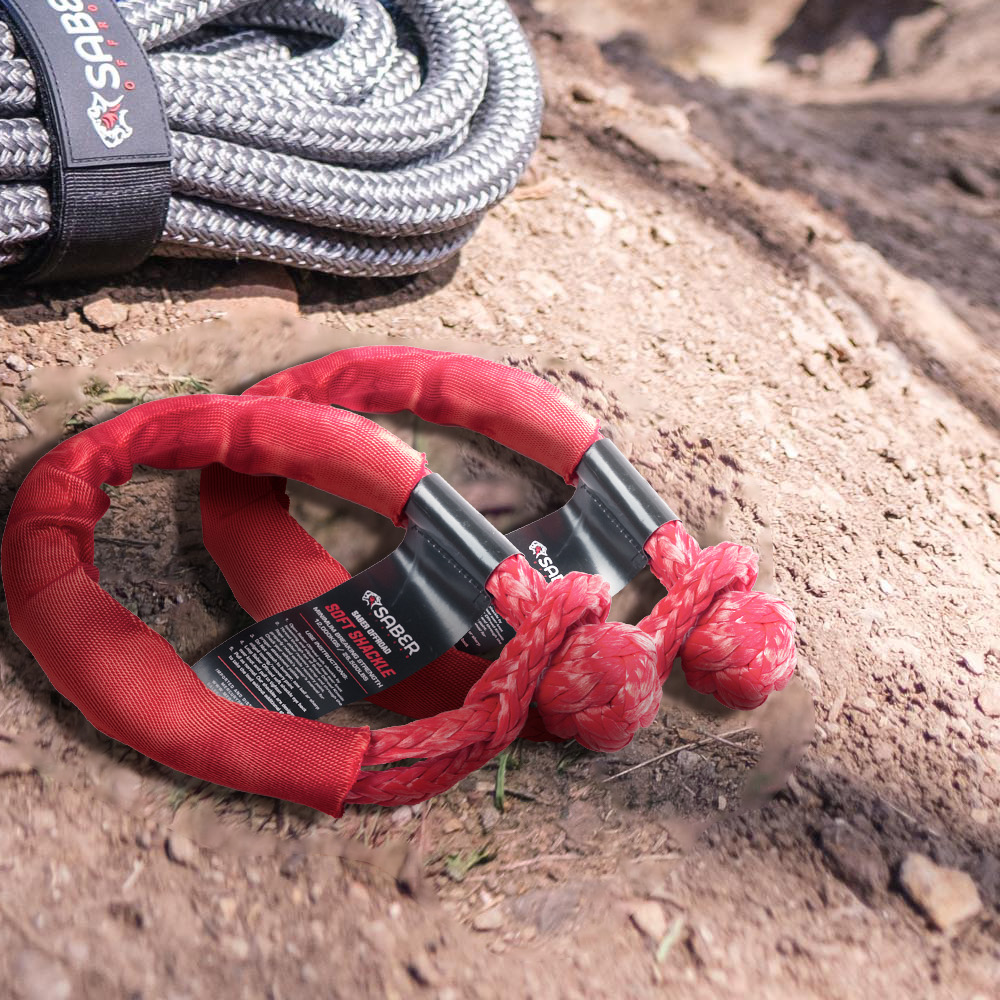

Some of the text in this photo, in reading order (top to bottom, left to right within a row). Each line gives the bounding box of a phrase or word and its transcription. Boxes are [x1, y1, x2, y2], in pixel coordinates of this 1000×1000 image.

[305, 630, 316, 642] USE
[313, 606, 384, 688] MINIMUM BREAKING STRENGTH
[324, 603, 357, 635] SOFT
[348, 626, 396, 678] SHACKLE
[351, 610, 370, 630] SABER
[366, 628, 392, 655] OFFROAD
[373, 606, 420, 656] SABER
